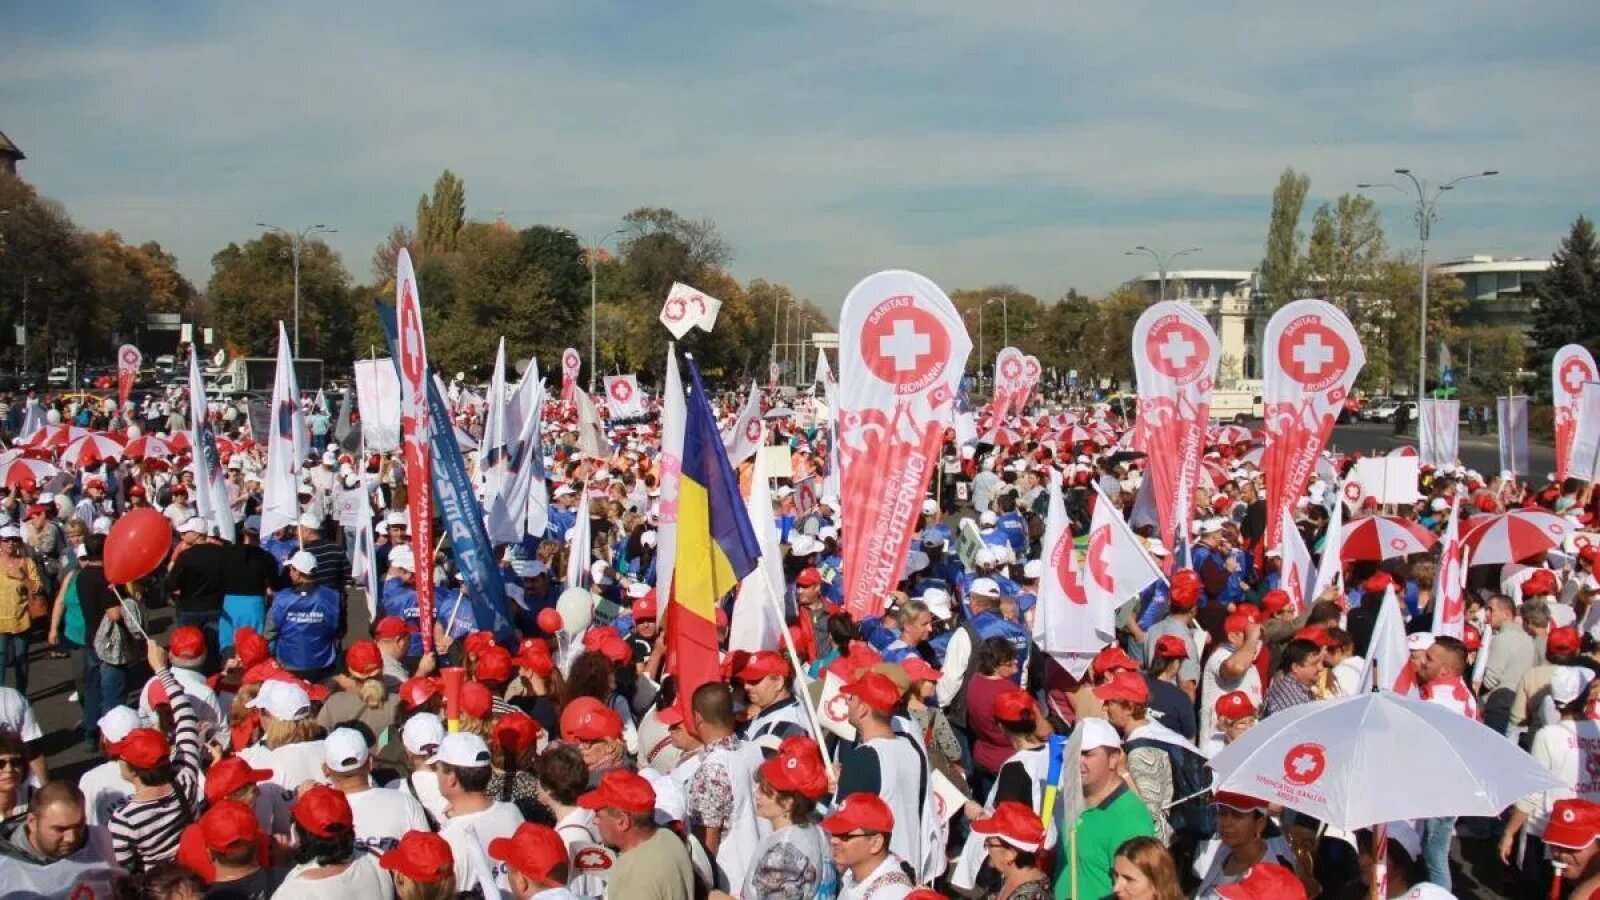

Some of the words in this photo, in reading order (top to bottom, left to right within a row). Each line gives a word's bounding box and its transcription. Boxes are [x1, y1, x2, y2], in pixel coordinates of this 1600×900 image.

[869, 297, 909, 325] SANITAS
[871, 559, 895, 598] MAI
[883, 451, 928, 558] PUTERNICI
